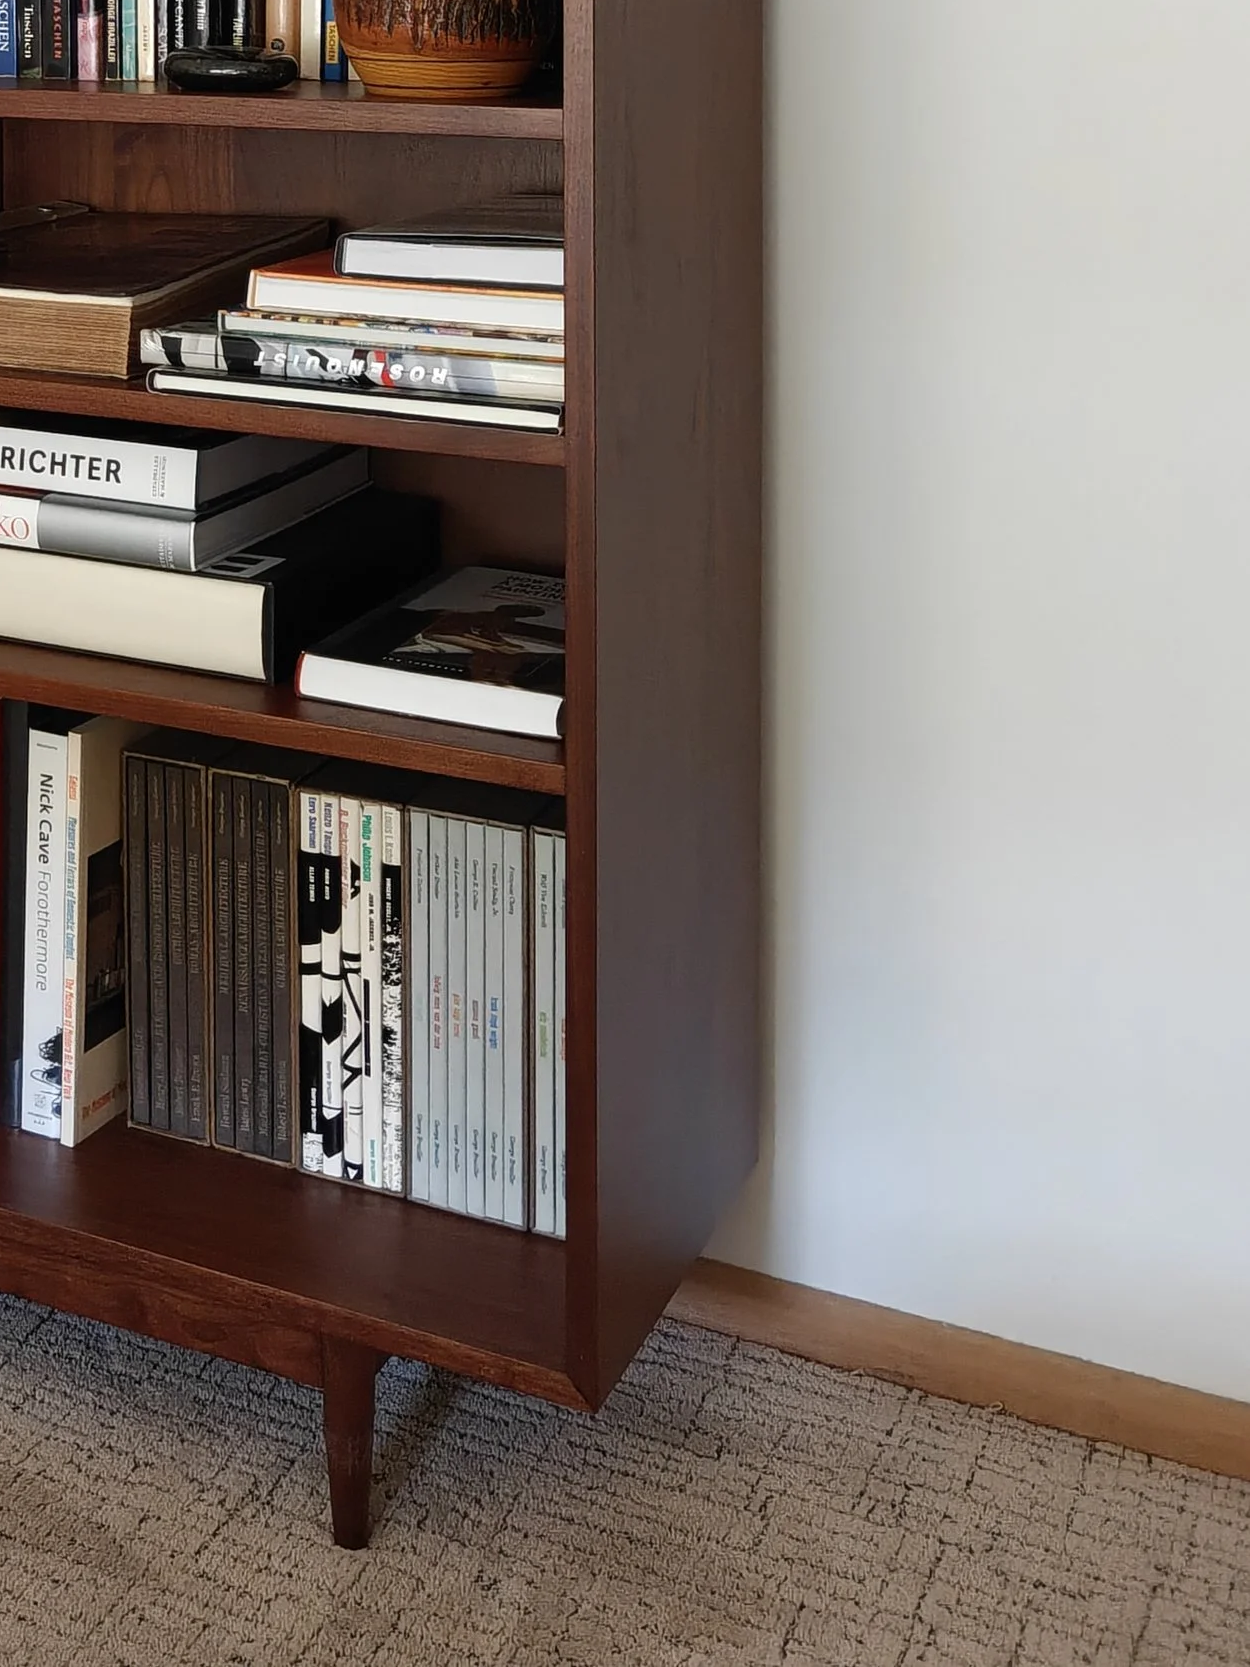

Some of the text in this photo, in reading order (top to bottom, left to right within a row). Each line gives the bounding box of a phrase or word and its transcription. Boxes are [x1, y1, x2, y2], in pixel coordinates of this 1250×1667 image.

[108, 25, 116, 62] BRAZILLER
[328, 24, 336, 61] TASCHEN
[0, 445, 122, 484] RICHTER
[35, 773, 54, 991] Nick Cave Forothermore
[362, 844, 373, 882] Johnson
